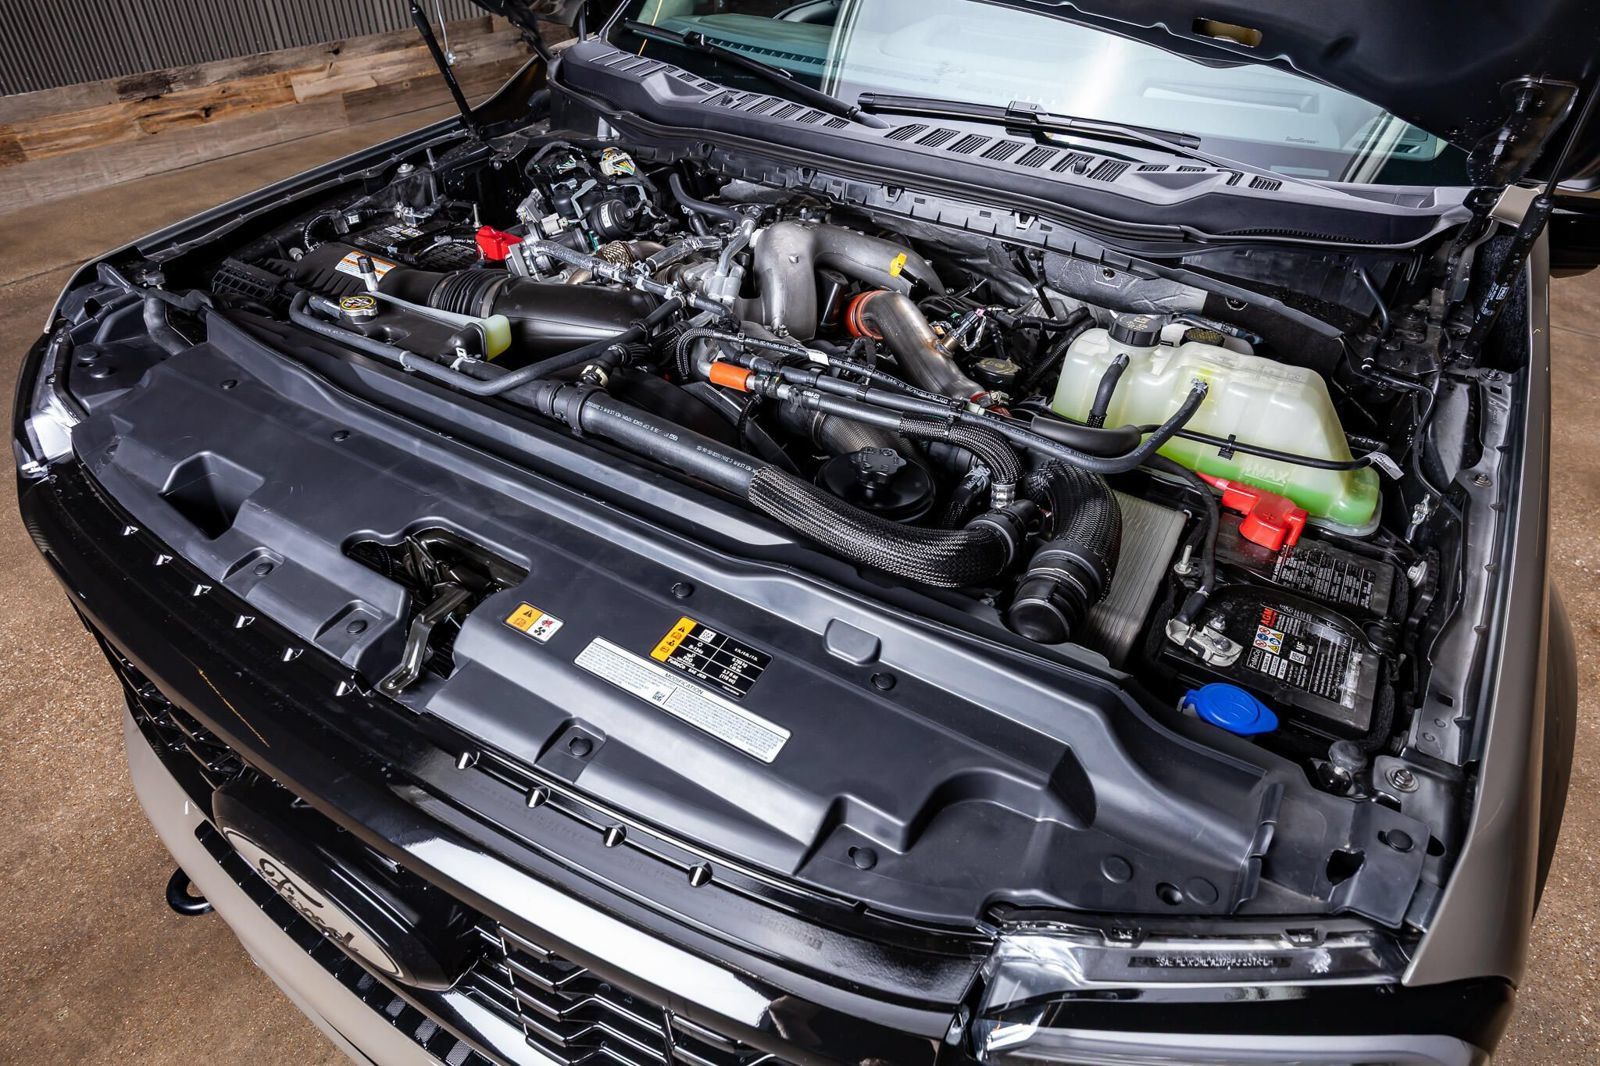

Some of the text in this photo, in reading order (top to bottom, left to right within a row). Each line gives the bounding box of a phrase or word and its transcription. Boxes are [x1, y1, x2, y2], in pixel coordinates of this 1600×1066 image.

[1260, 607, 1273, 626] AGM
[1249, 648, 1261, 669] FoMoCo
[665, 673, 703, 695] MODIFICATION
